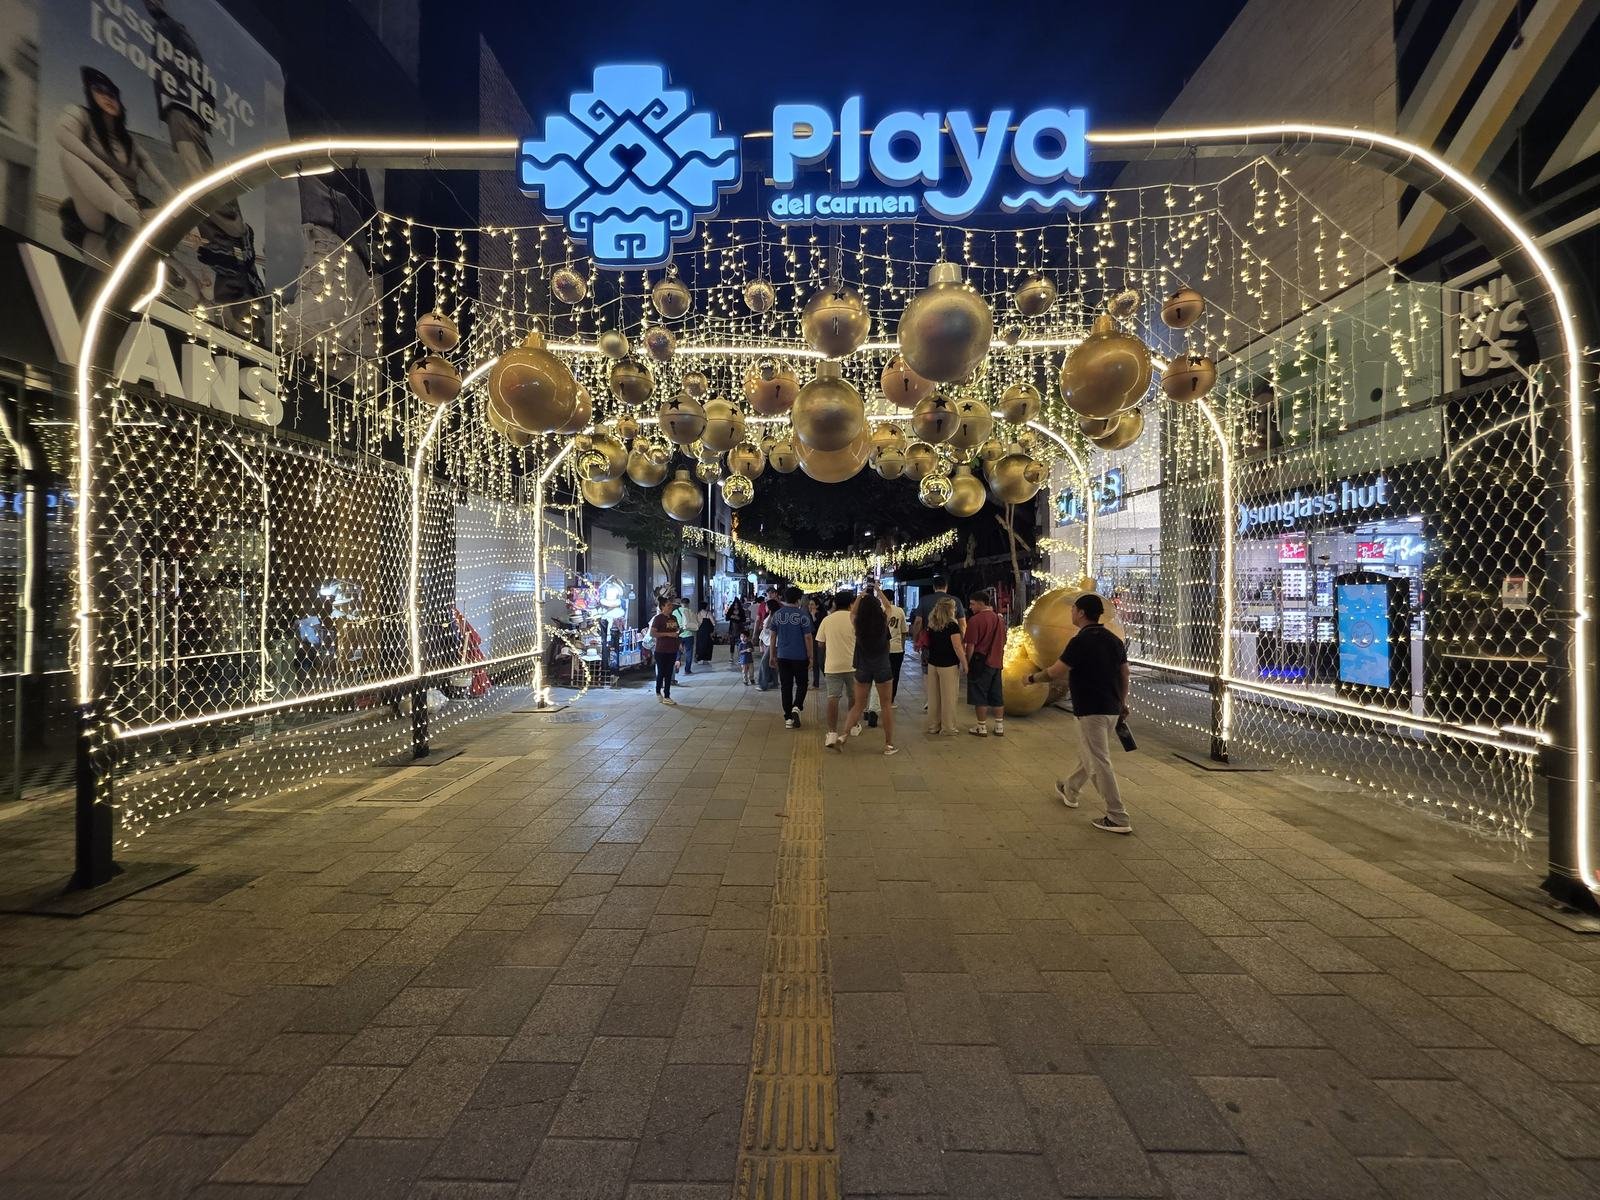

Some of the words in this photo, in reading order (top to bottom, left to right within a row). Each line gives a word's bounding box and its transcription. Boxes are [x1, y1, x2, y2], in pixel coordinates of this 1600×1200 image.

[772, 95, 1088, 219] Playa
[771, 193, 811, 215] del
[1249, 491, 1338, 527] sunglass
[1342, 475, 1389, 511] hut
